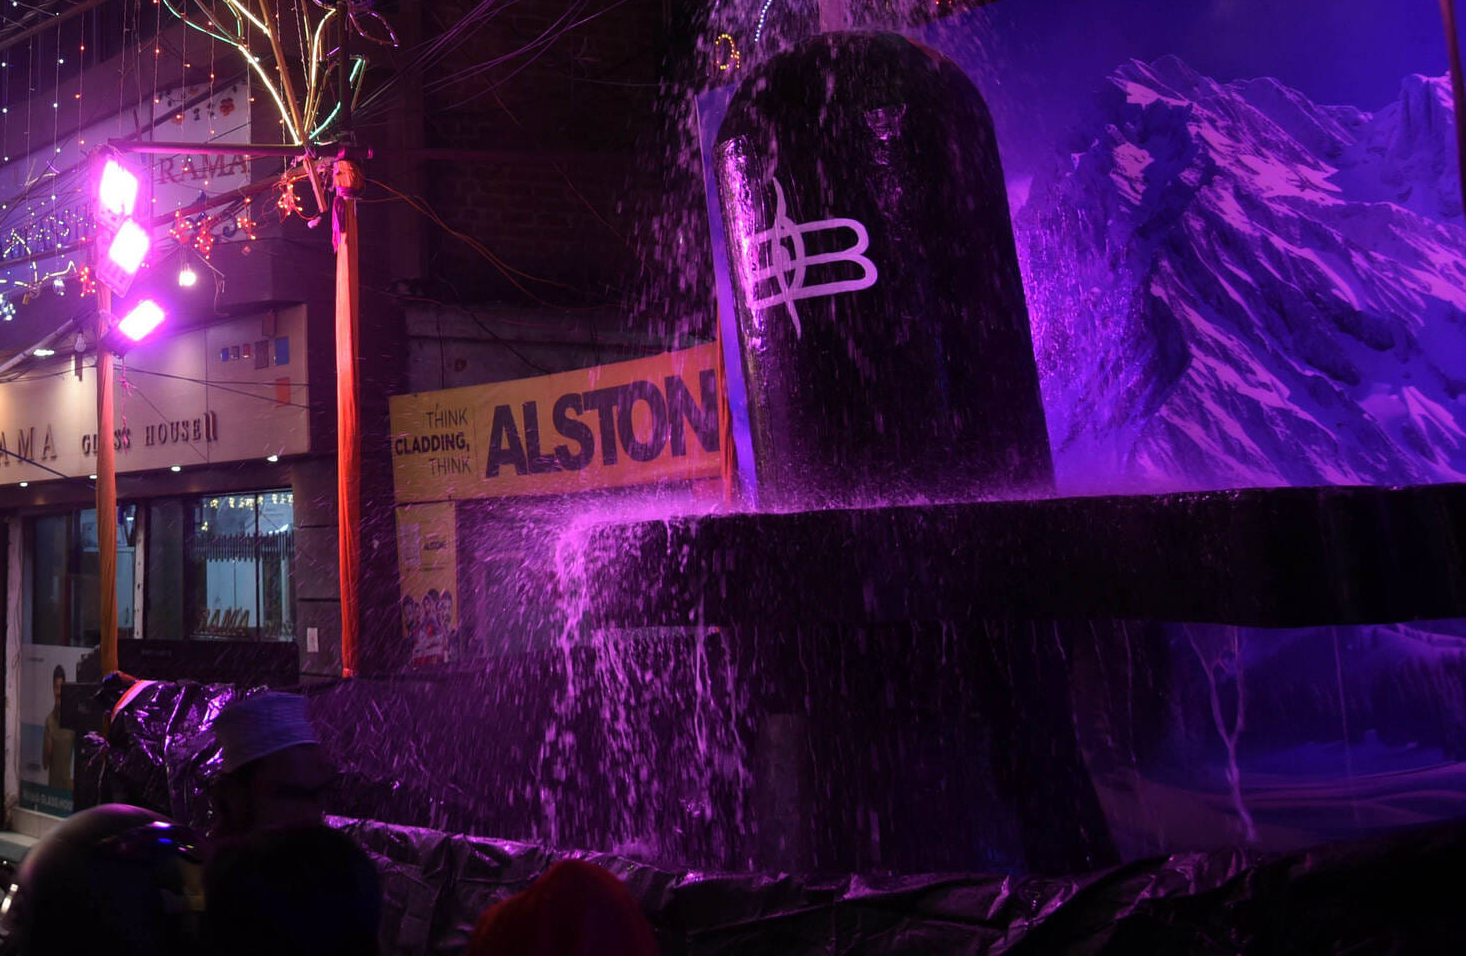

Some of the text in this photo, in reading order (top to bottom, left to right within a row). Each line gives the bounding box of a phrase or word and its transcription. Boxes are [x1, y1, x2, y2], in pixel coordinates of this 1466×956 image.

[157, 153, 252, 185] RAMA
[424, 405, 469, 430] THINK
[81, 428, 132, 457] GLSS
[144, 418, 202, 446] HOUSE
[394, 431, 471, 457] CLADDING,
[429, 454, 472, 477] THINK
